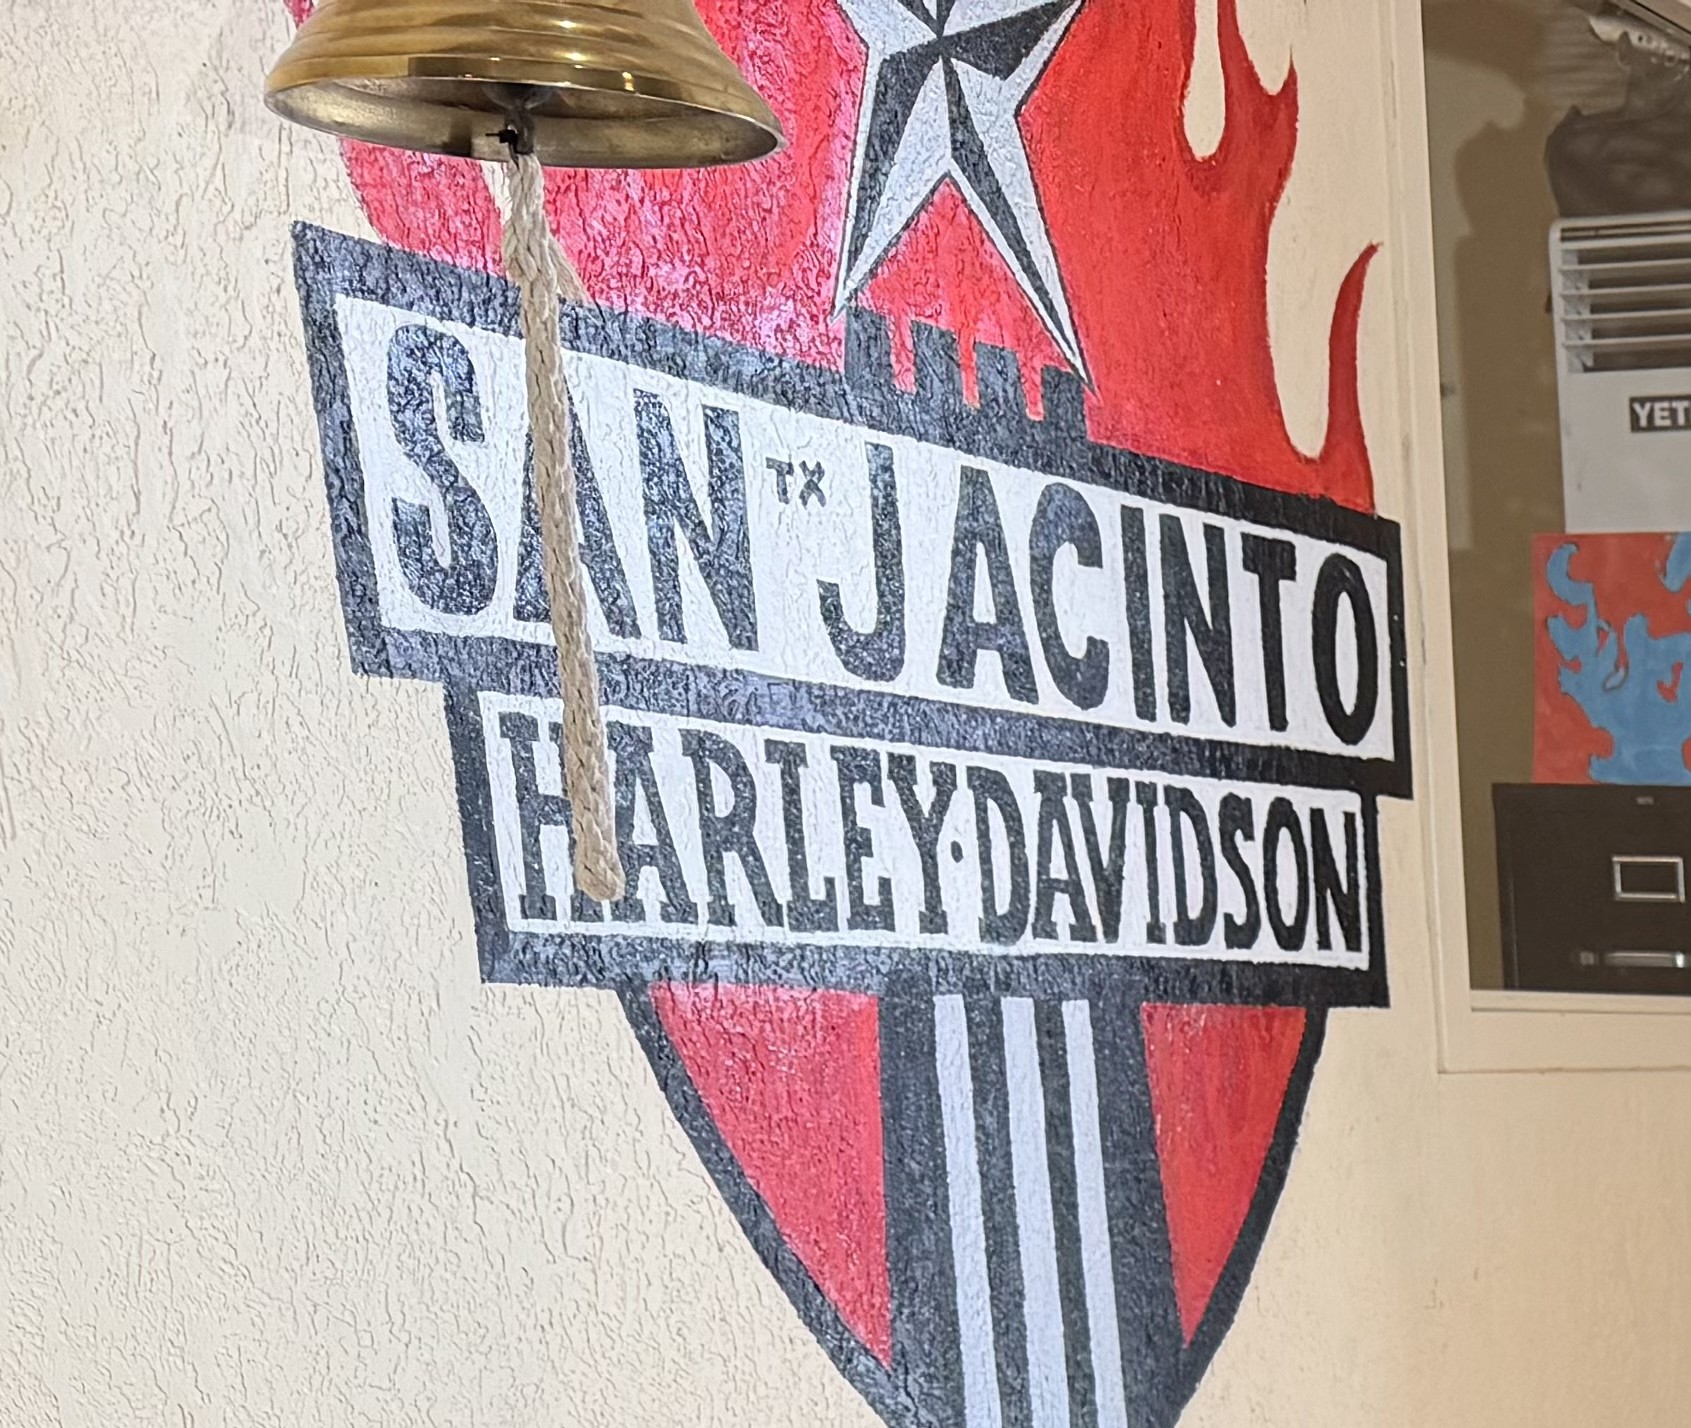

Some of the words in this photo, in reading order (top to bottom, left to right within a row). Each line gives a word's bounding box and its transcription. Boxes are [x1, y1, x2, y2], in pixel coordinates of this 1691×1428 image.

[387, 323, 760, 652] SAN
[764, 455, 831, 507] TX
[817, 440, 1380, 747] JACINTO
